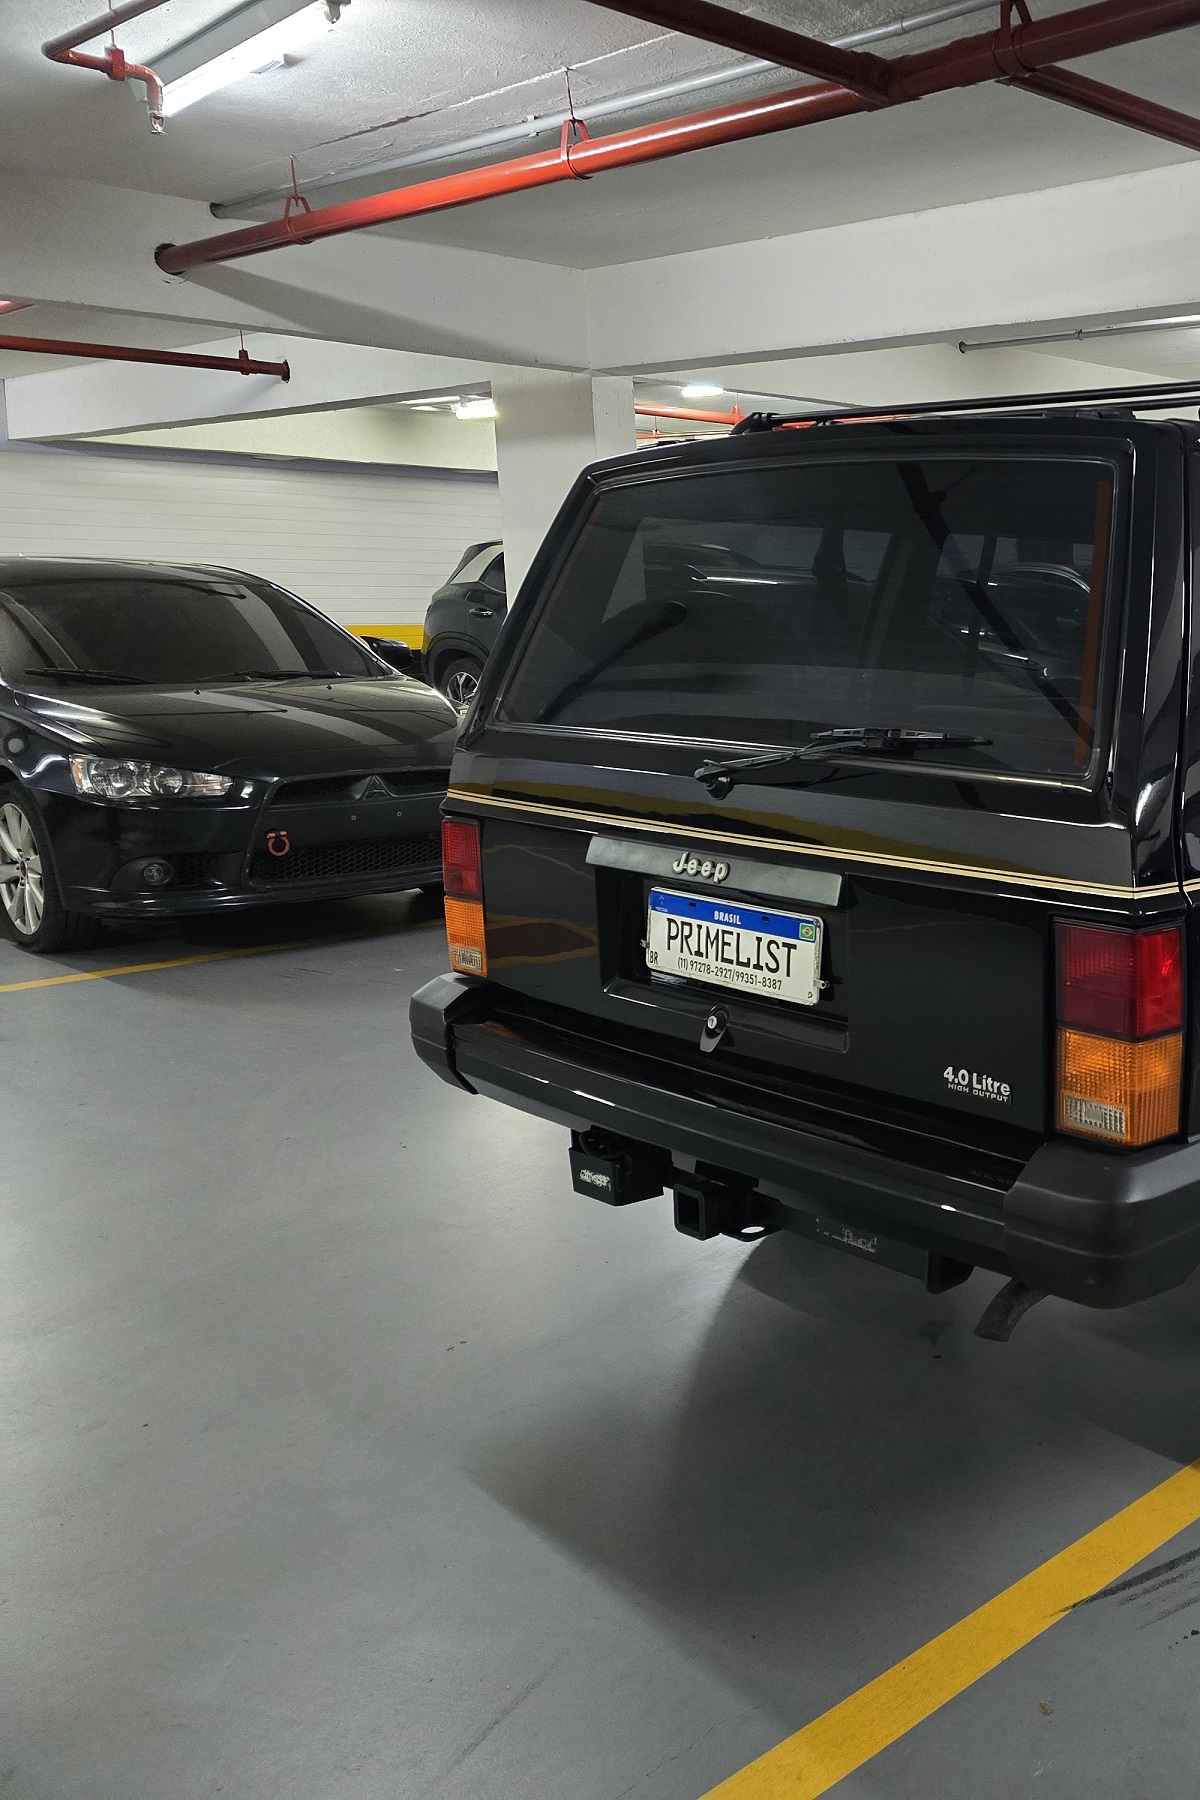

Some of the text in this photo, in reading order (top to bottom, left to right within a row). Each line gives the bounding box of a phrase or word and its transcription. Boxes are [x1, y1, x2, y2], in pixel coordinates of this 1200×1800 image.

[673, 852, 729, 882] Jeep
[713, 910, 741, 925] BRASIL
[649, 950, 659, 965] BR
[666, 917, 797, 977] PRIMELIST
[677, 957, 689, 971] (11)
[943, 1066, 1010, 1096] 4.0 Litre
[947, 1082, 1008, 1103] HIGH OUTPUT
